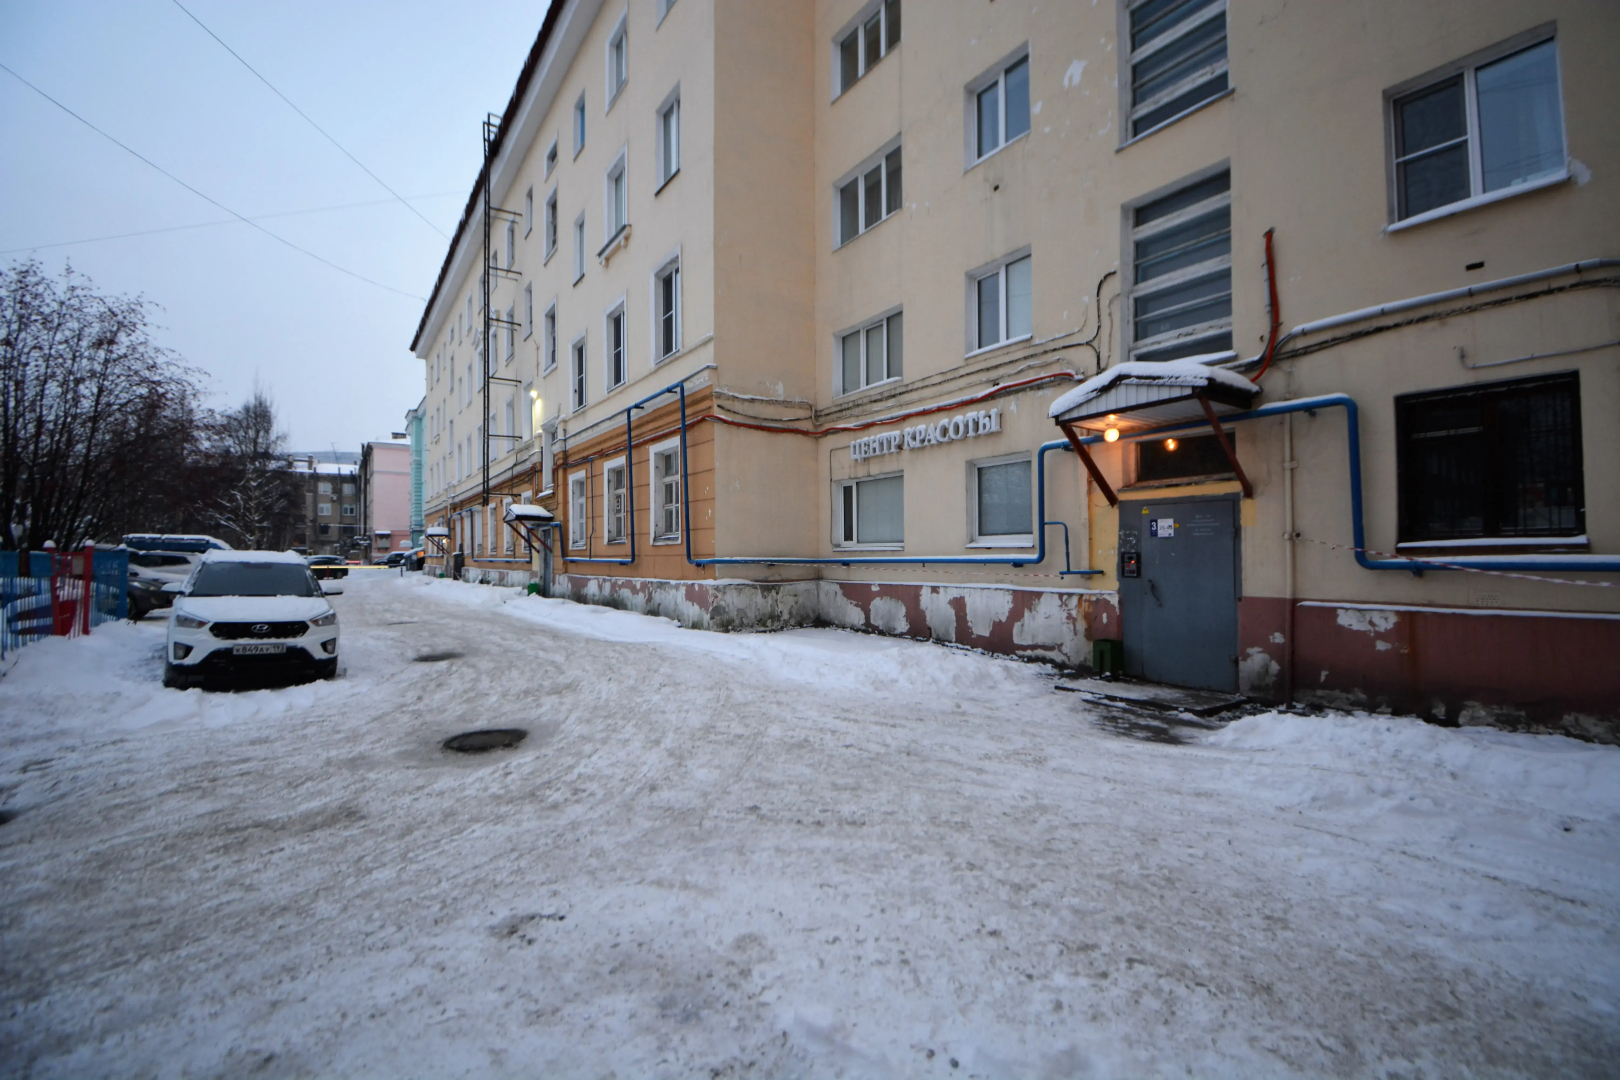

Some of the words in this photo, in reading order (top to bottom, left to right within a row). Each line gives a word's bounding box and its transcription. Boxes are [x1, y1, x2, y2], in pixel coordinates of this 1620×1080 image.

[850, 430, 902, 462] ЦЕНТР
[903, 408, 1001, 449] КРАСОТЫ
[1151, 521, 1157, 531] 3
